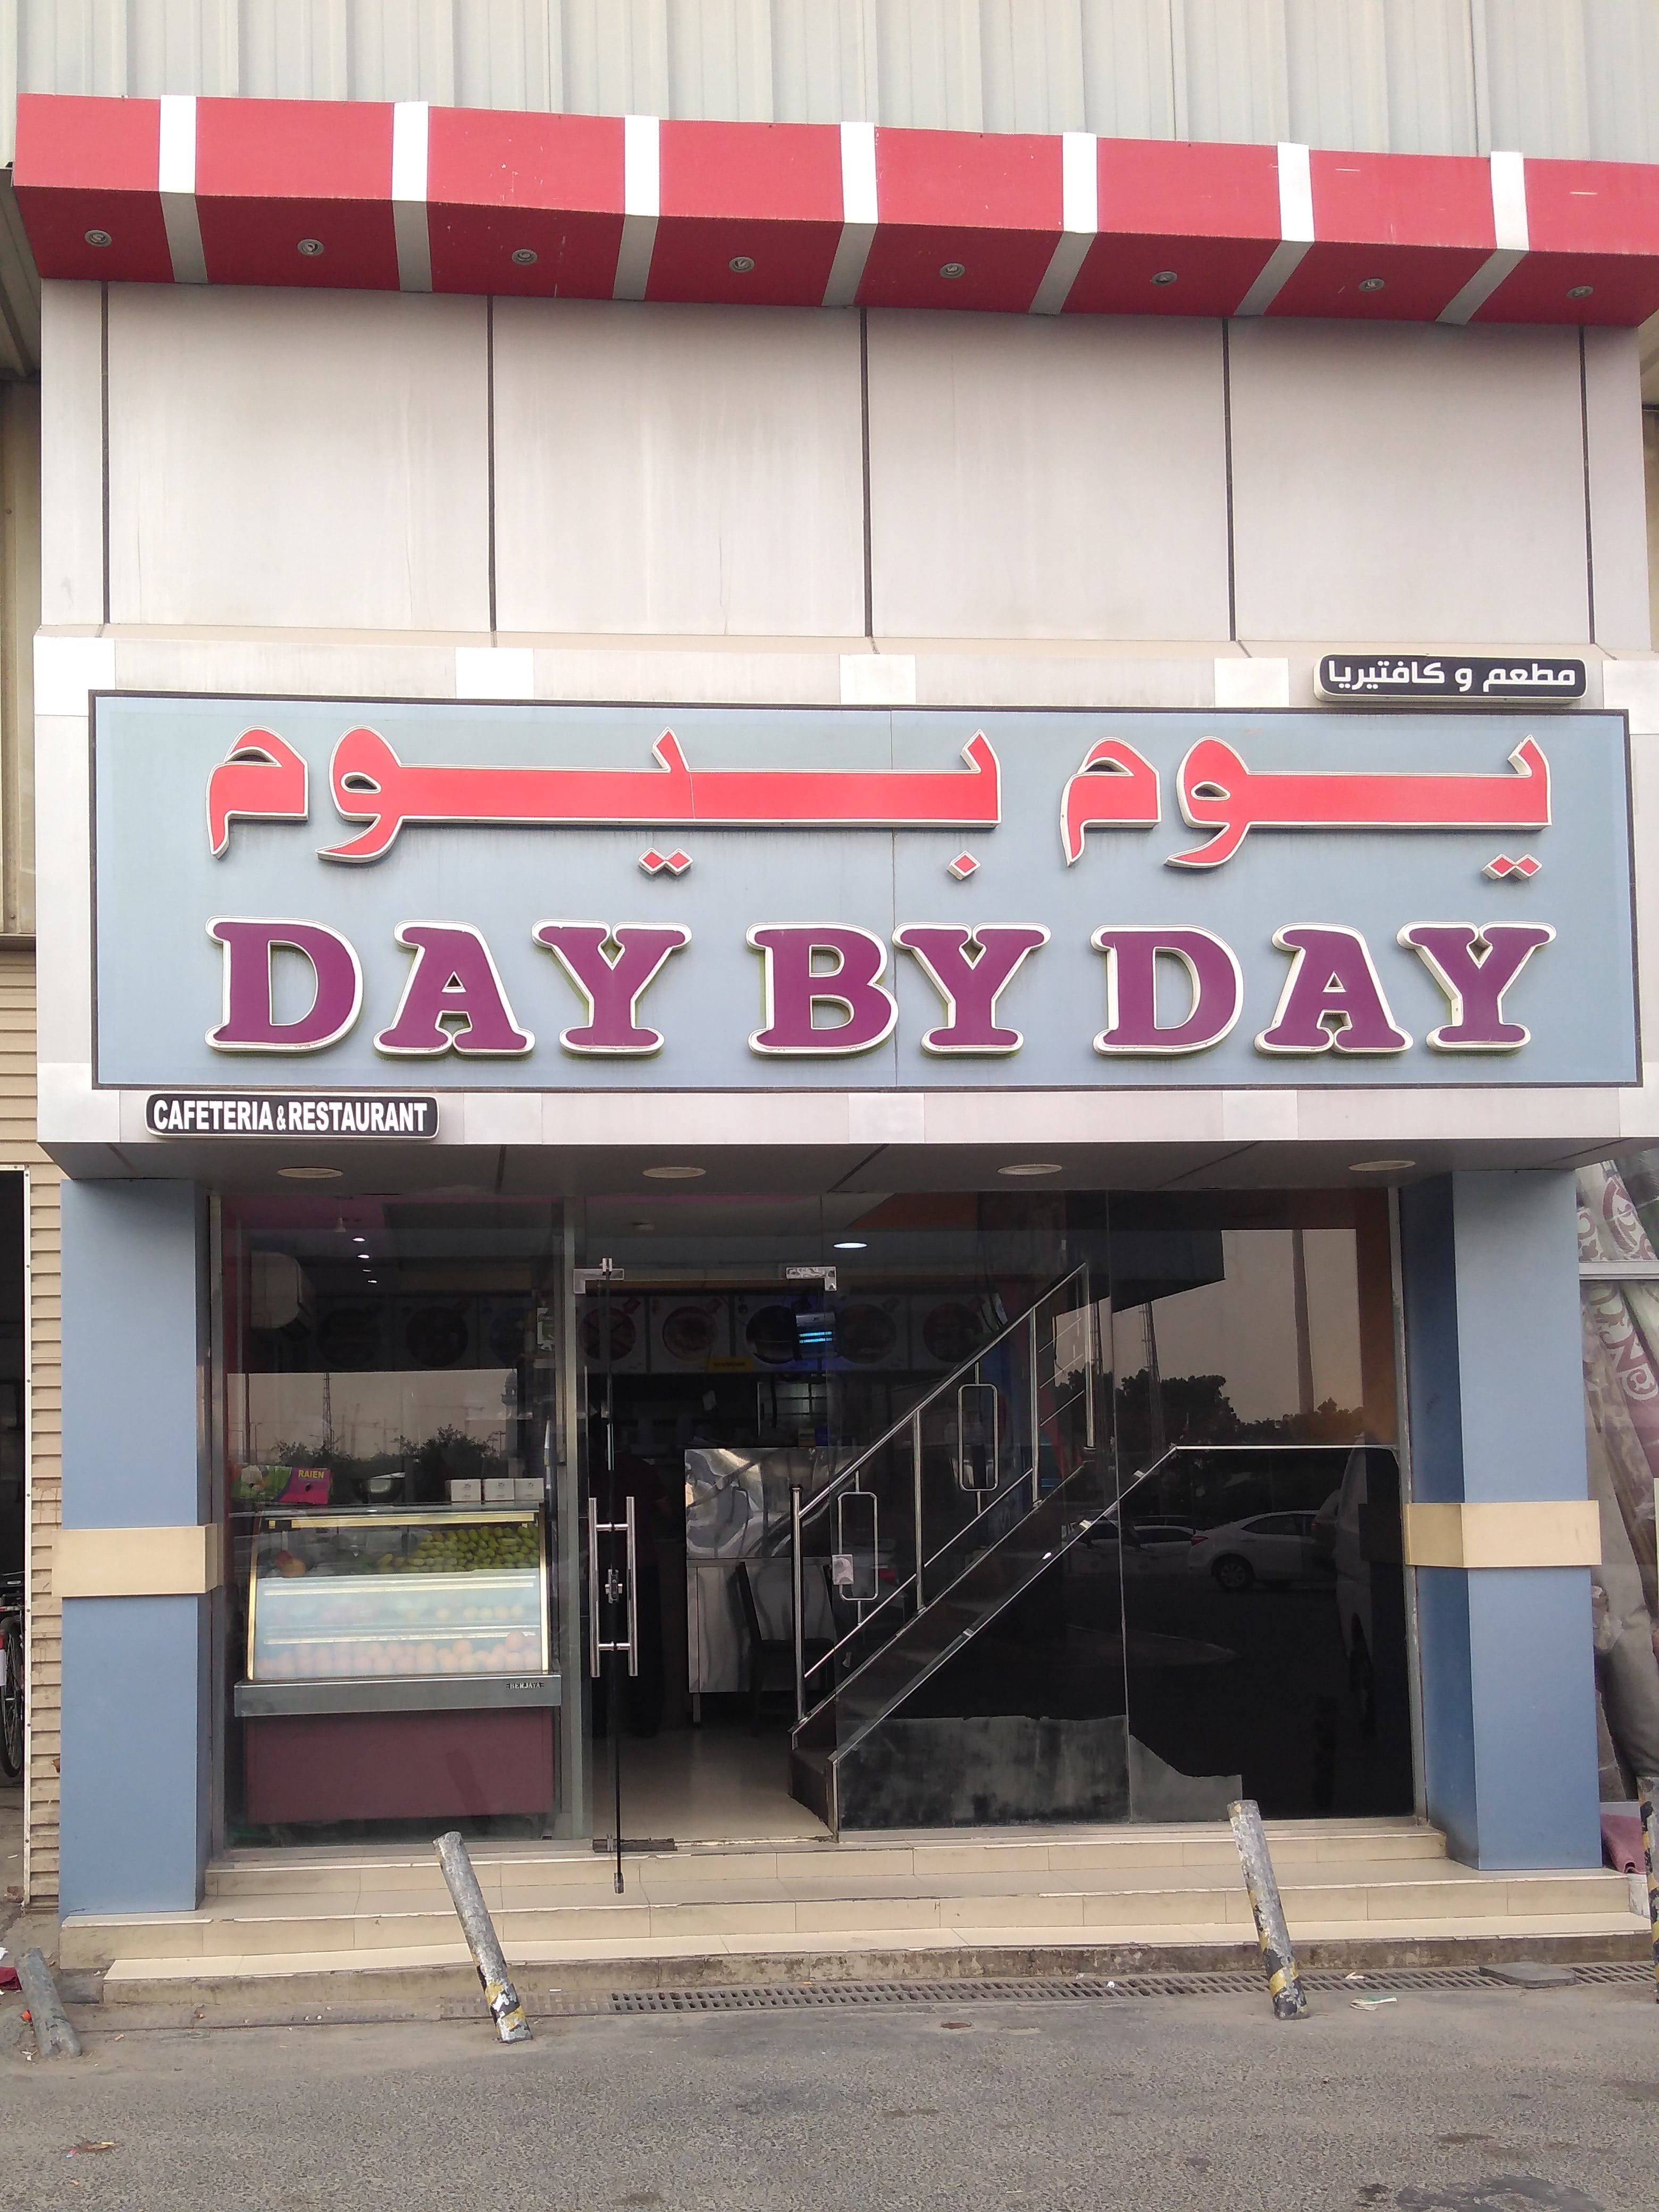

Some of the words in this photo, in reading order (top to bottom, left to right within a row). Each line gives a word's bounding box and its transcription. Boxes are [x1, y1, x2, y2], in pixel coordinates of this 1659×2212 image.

[1328, 659, 1445, 690] كافتيريا
[1455, 666, 1472, 692] و
[1482, 663, 1576, 693] مطعم
[206, 726, 1002, 880] بيوم
[1060, 734, 1552, 879] يوم
[205, 916, 692, 1055] DAY
[745, 921, 1051, 1055] BY
[1091, 921, 1556, 1055] DAY
[154, 1100, 273, 1131] CAFETERIA
[276, 1104, 286, 1130] &
[289, 1101, 427, 1132] RESTAURANT
